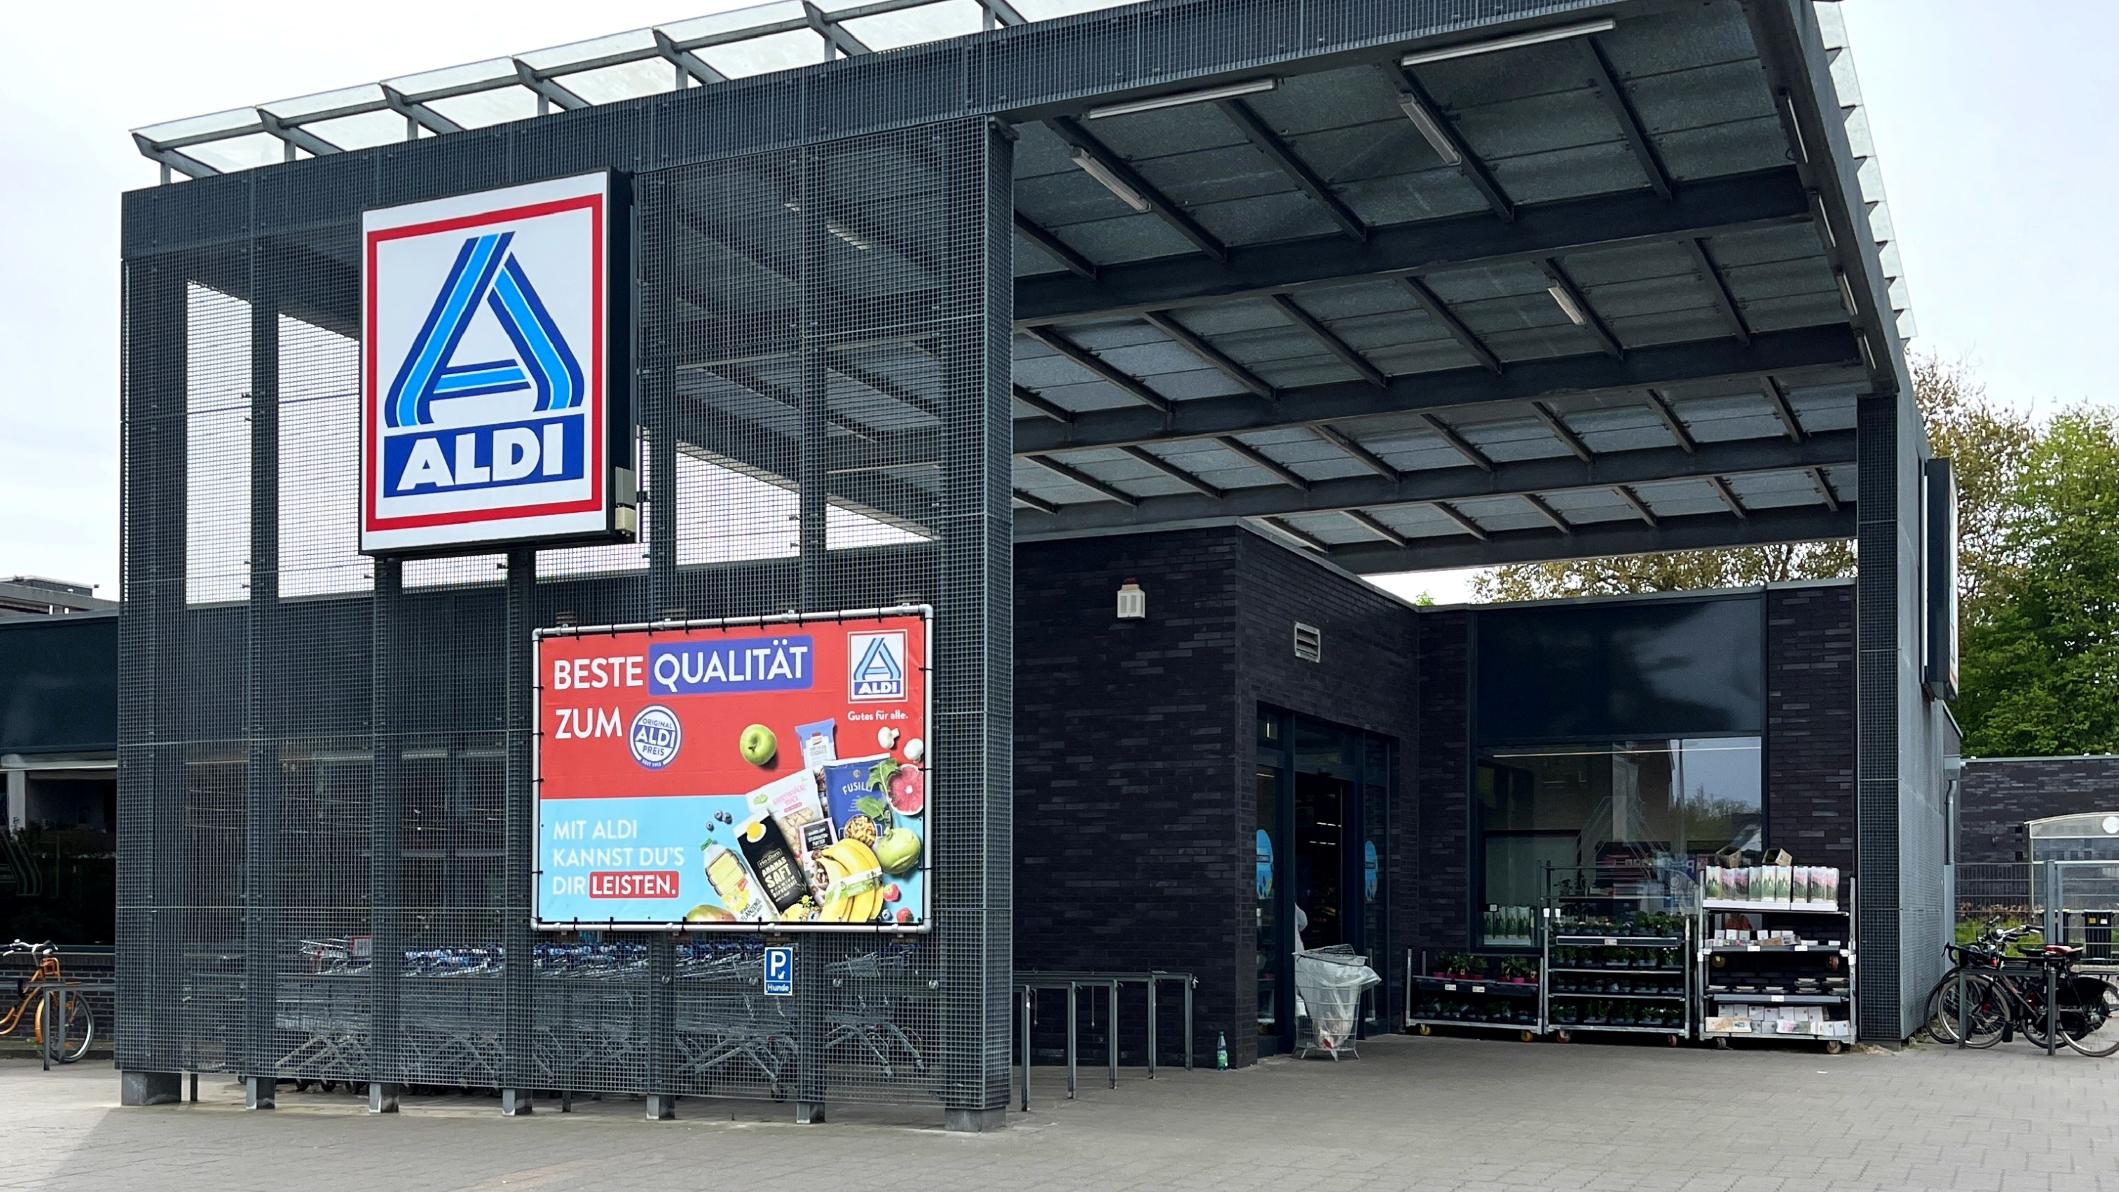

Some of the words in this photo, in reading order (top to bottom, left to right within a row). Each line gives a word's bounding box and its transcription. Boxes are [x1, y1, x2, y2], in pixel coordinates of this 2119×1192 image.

[397, 423, 564, 490] ALDI
[554, 656, 644, 690] BESTE
[654, 639, 808, 692] QUALITÄT
[858, 682, 898, 695] ALDI
[555, 706, 623, 739] ZUM
[642, 718, 673, 729] ORIGINAL
[847, 711, 873, 721] Gutes
[875, 710, 888, 720] für
[890, 709, 909, 719] alle.
[634, 726, 676, 748] ALDI
[642, 745, 665, 756] PREIS
[553, 820, 587, 840] MIT
[592, 819, 637, 839] ALDI
[553, 847, 634, 867] KANNST
[552, 876, 585, 895] DIR
[592, 875, 676, 895] LEISTEN.
[765, 863, 792, 889] SAFT
[770, 951, 787, 977] P
[767, 983, 790, 992] Hunde
